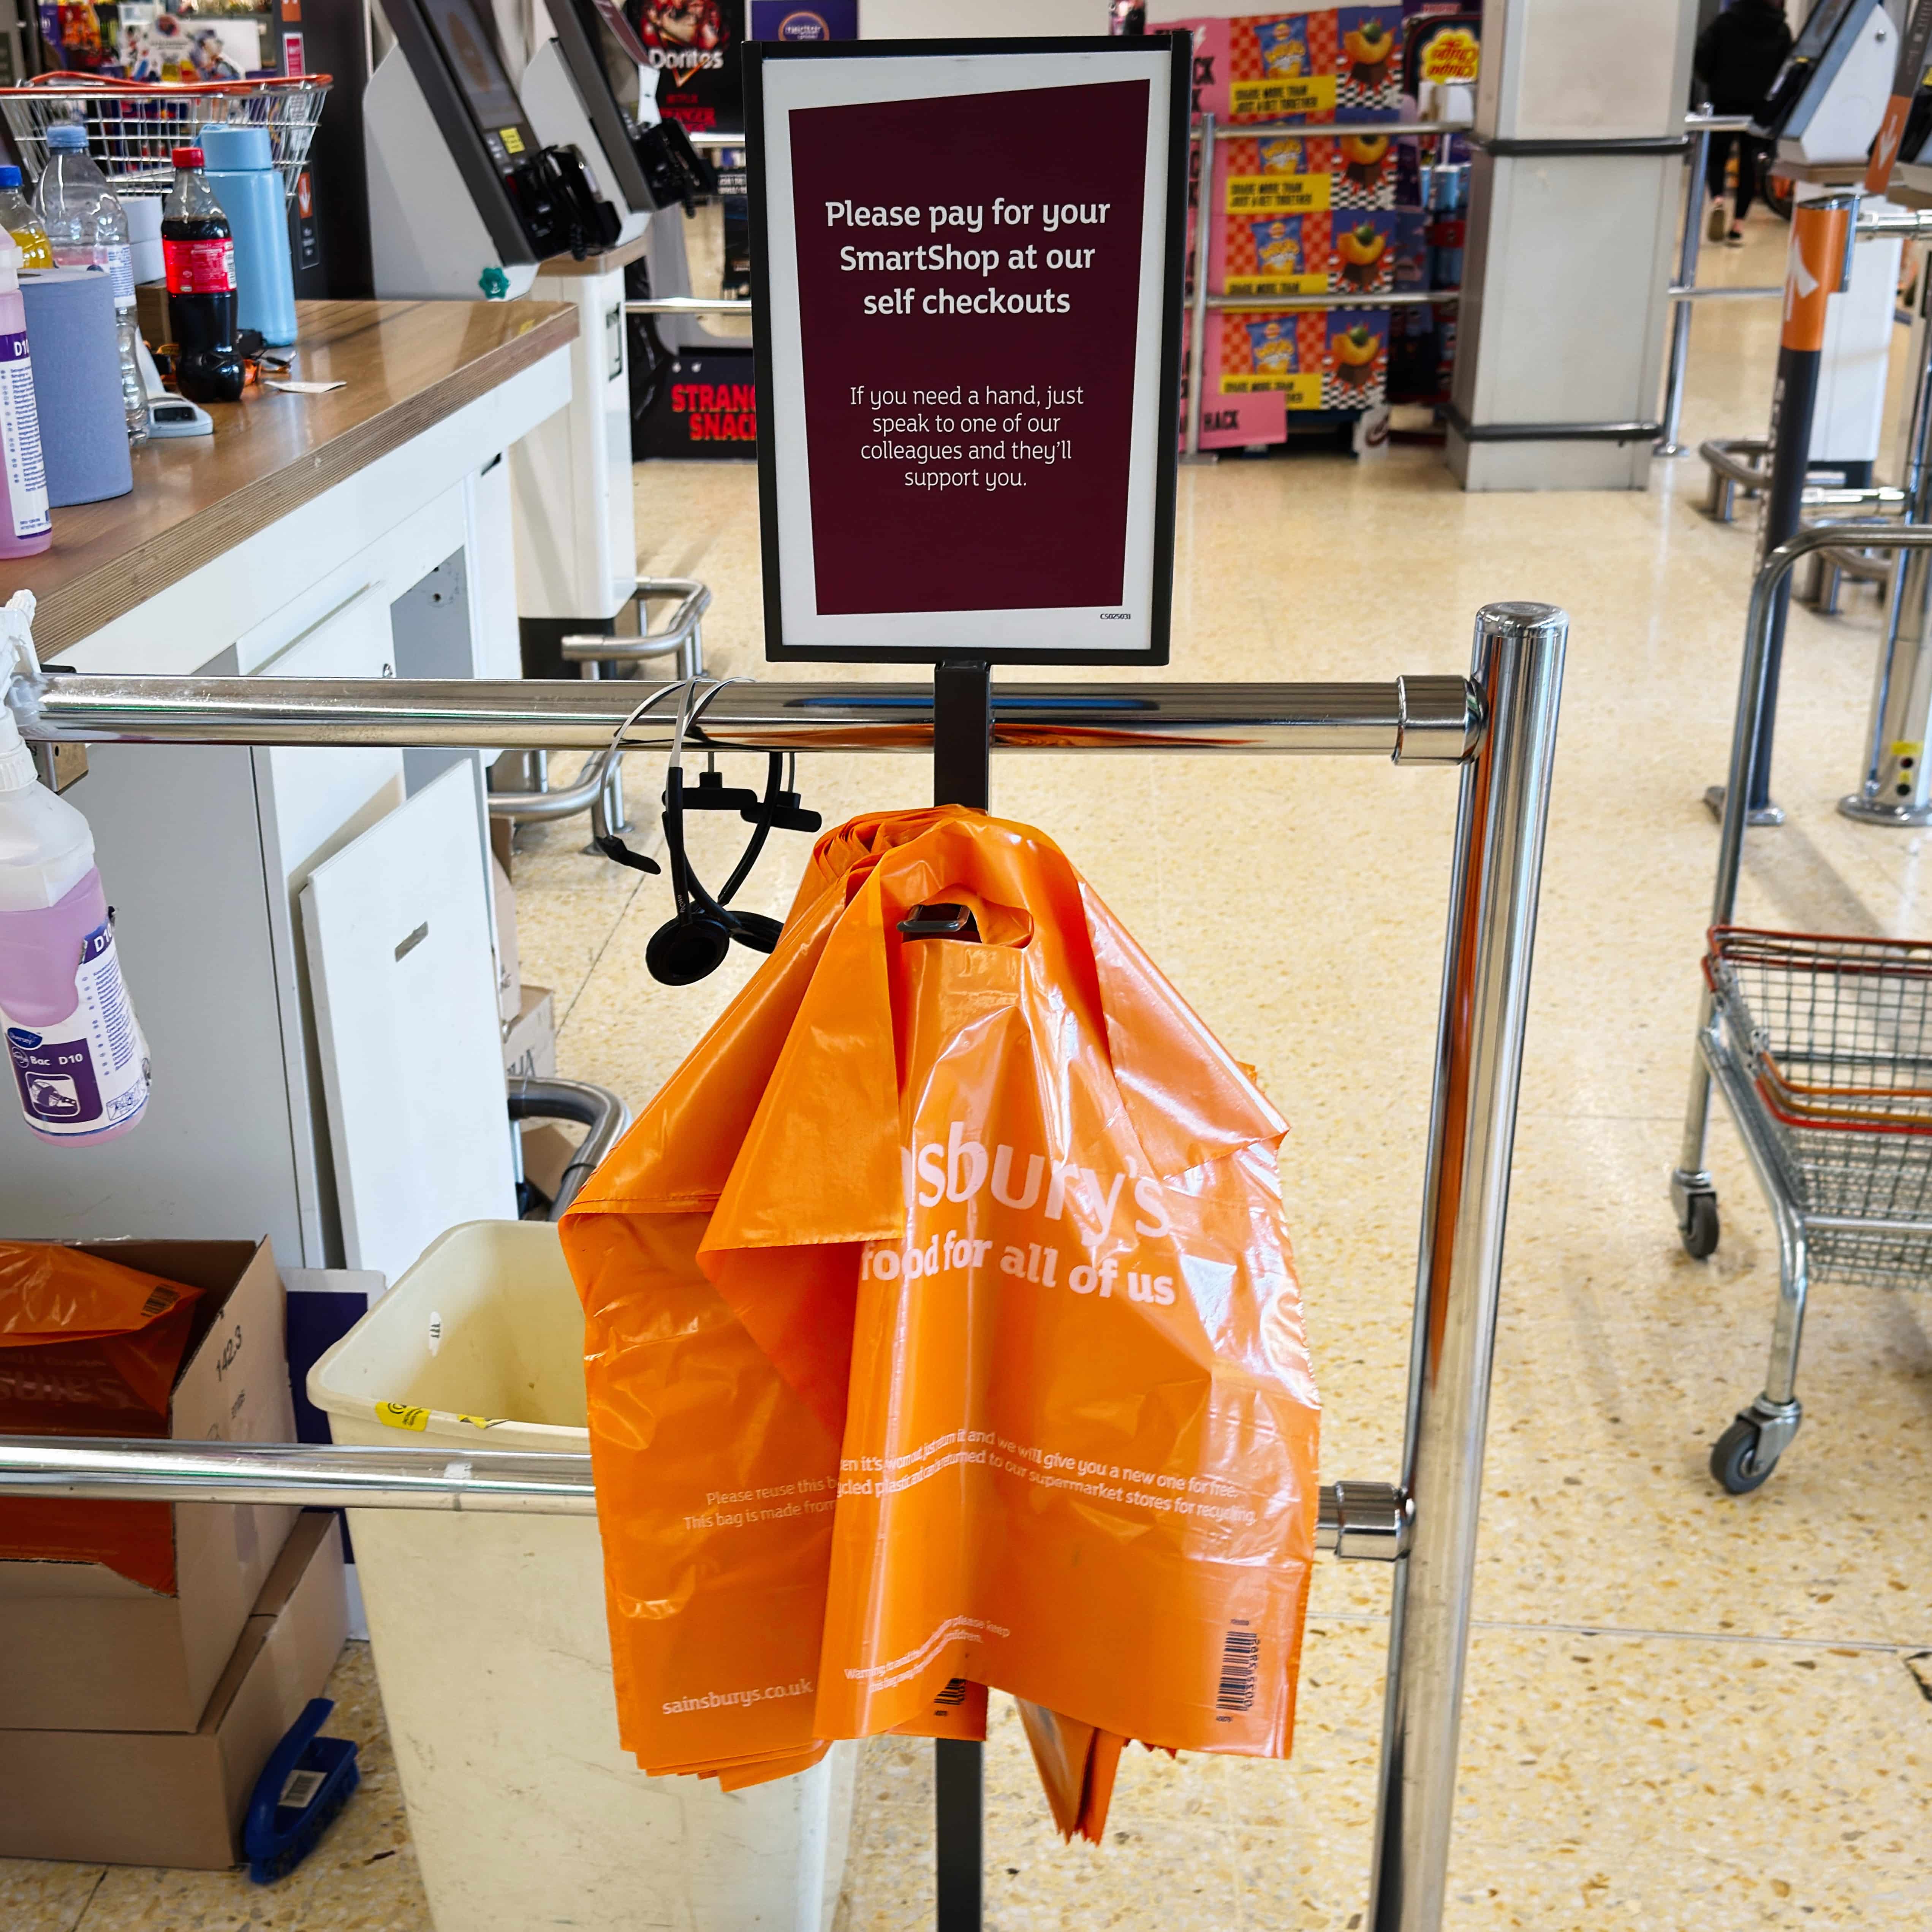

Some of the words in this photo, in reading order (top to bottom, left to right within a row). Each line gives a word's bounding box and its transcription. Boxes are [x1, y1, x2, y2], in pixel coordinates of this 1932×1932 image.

[648, 48, 724, 69] Doritos
[825, 199, 920, 227] Please
[929, 204, 983, 233] pay
[992, 197, 1033, 225] for
[1042, 202, 1110, 232] your
[840, 243, 999, 277] SmartShop
[1008, 244, 1037, 269] at
[1046, 248, 1095, 269] our
[864, 288, 915, 315] self
[922, 287, 1070, 314] checkouts
[850, 386, 864, 405] If
[870, 390, 907, 410] you
[913, 386, 962, 405] need
[968, 390, 979, 405] a
[986, 385, 1040, 408] hand,
[1045, 386, 1084, 409] just
[873, 414, 929, 437] speak
[935, 415, 954, 432] to
[960, 417, 996, 432] one
[1003, 413, 1022, 432] of
[1028, 417, 1061, 432] our
[861, 440, 962, 464] colleagues
[968, 441, 1005, 459] and
[1011, 440, 1071, 464] they’ll
[905, 469, 979, 491] support
[986, 472, 1027, 491] you.
[30, 1056, 51, 1066] Bac
[58, 1053, 83, 1065] D10
[901, 1121, 1169, 1247] sbury's
[943, 1229, 992, 1272] for
[1000, 1243, 1058, 1289] all
[1068, 1258, 1119, 1299] of
[1127, 1271, 1177, 1306] us
[861, 1456, 883, 1471] it's
[967, 1430, 996, 1444] and
[997, 1436, 1017, 1453] we
[1017, 1445, 1043, 1464] will
[1044, 1452, 1076, 1469] give
[1078, 1460, 1107, 1476] you
[1109, 1466, 1119, 1478] a
[1122, 1467, 1156, 1485] new
[1157, 1474, 1186, 1491] one
[1188, 1476, 1210, 1494] for
[706, 1491, 753, 1505] Please
[756, 1484, 795, 1500] reuse
[797, 1478, 824, 1494] this
[988, 1452, 1004, 1468] to
[1005, 1460, 1028, 1478] our
[1029, 1471, 1123, 1502] supermarket
[1125, 1490, 1172, 1511] stores
[1174, 1496, 1196, 1514] for
[684, 1515, 714, 1530] This
[715, 1512, 744, 1528] bag
[745, 1509, 758, 1522] is
[760, 1503, 801, 1520] made
[662, 1678, 814, 1715] sainsburys.co.uk
